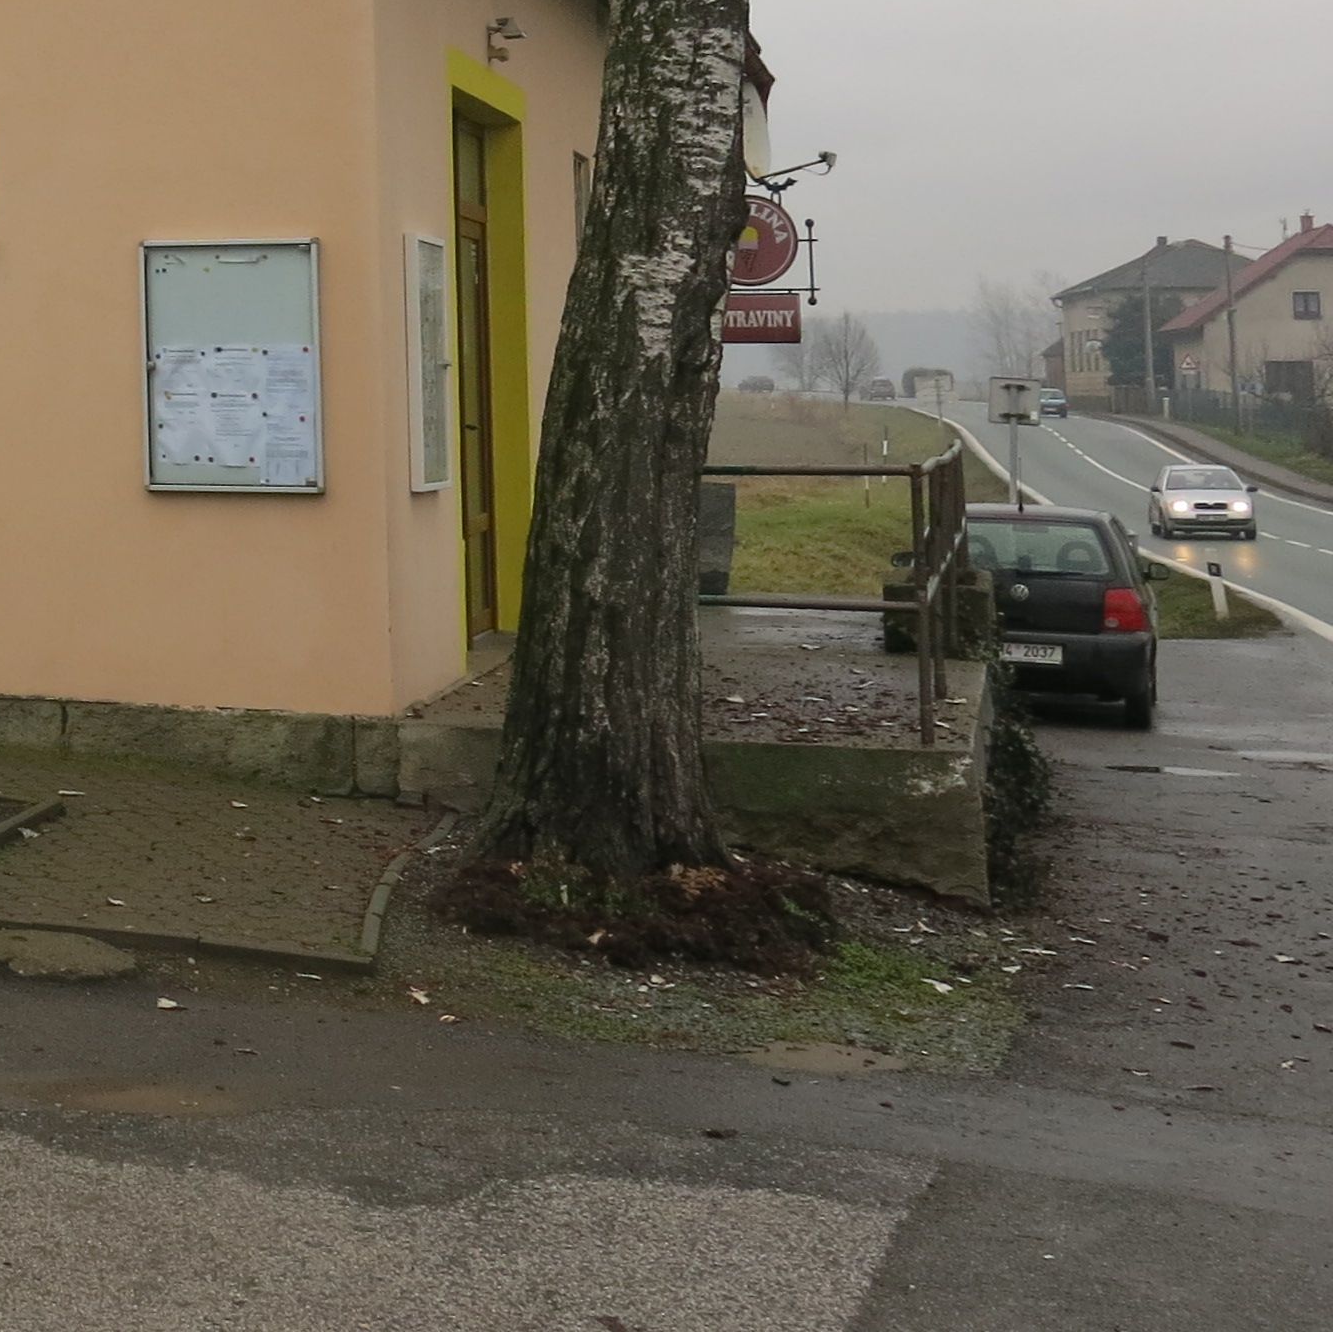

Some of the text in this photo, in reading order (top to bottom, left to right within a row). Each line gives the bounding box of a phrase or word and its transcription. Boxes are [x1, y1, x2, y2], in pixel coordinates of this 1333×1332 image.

[748, 203, 789, 244] LINA
[724, 310, 795, 328] TRAVINY
[1023, 645, 1055, 658] 2037
